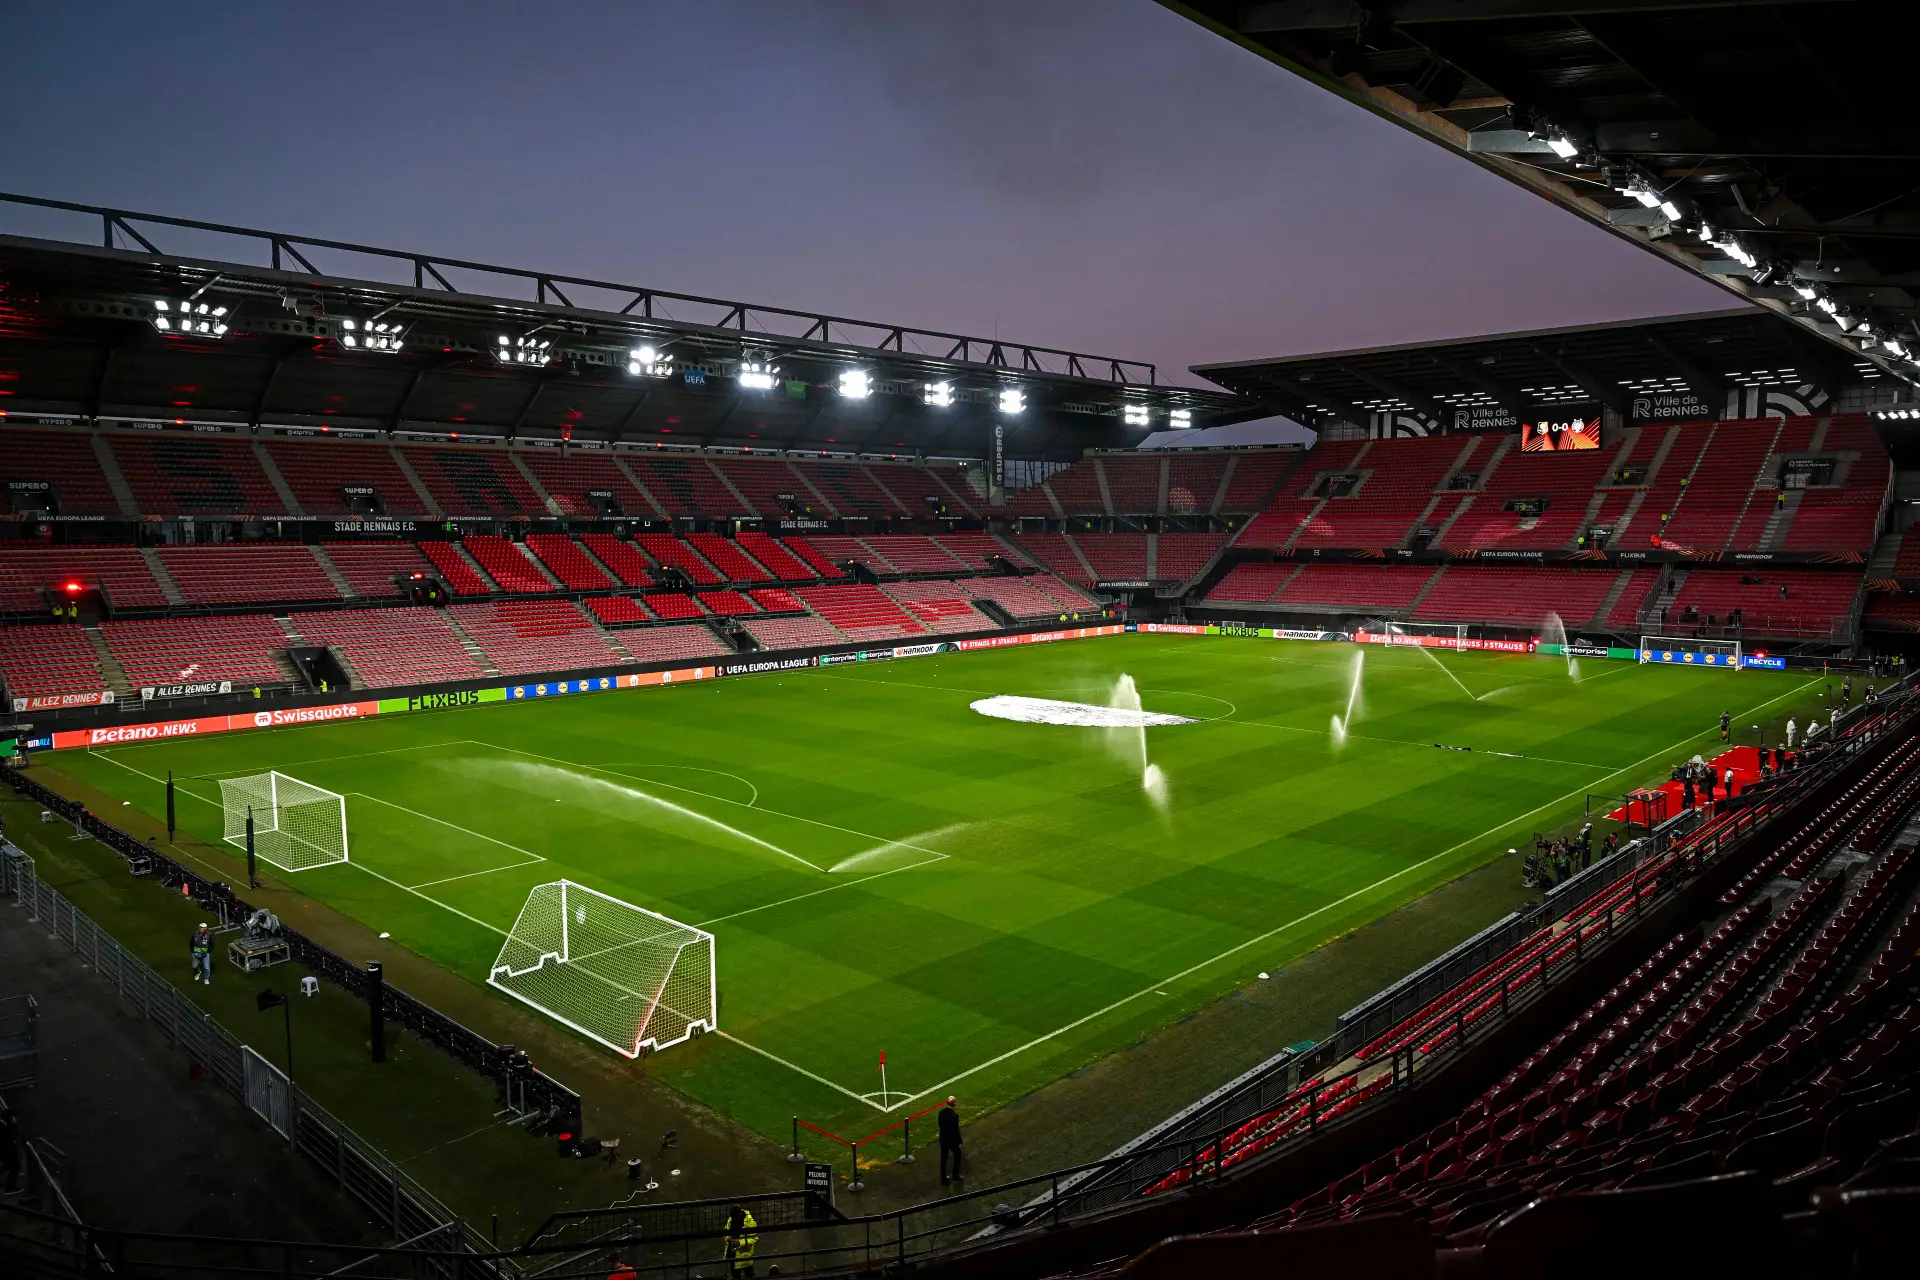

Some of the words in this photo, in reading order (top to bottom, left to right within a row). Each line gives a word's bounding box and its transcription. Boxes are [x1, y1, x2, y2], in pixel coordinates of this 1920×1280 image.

[684, 375, 705, 385] UEFA
[1654, 396, 1680, 407] Ville
[1682, 395, 1698, 405] de
[1472, 408, 1494, 418] Ville
[1496, 407, 1509, 416] de
[39, 418, 65, 426] HYPER
[8, 482, 40, 490] SUPER
[334, 521, 362, 532] STADE
[363, 521, 401, 532] RENNAIS
[402, 521, 417, 532] F.C.
[780, 520, 796, 529] STADE
[797, 520, 819, 529] RENNAIS
[1157, 625, 1197, 633] Swissquote
[969, 640, 990, 648] STRAUSS
[998, 637, 1018, 645] STRAUSS
[1447, 639, 1480, 647] STRAUSS
[1488, 641, 1523, 650] STRAUSS
[861, 650, 893, 659] enterprise
[1563, 646, 1608, 656] enterprise
[823, 653, 857, 663] enterprise
[1748, 658, 1782, 666] RECYCLE
[726, 664, 748, 675] UEFA
[749, 661, 779, 673] EUROPA
[780, 658, 809, 670] LEAGUE
[157, 685, 183, 697] ALLEZ
[185, 683, 217, 695] RENNES
[31, 695, 60, 708] ALLEZ
[62, 693, 98, 705] RENNES
[274, 705, 357, 724] Swissquote
